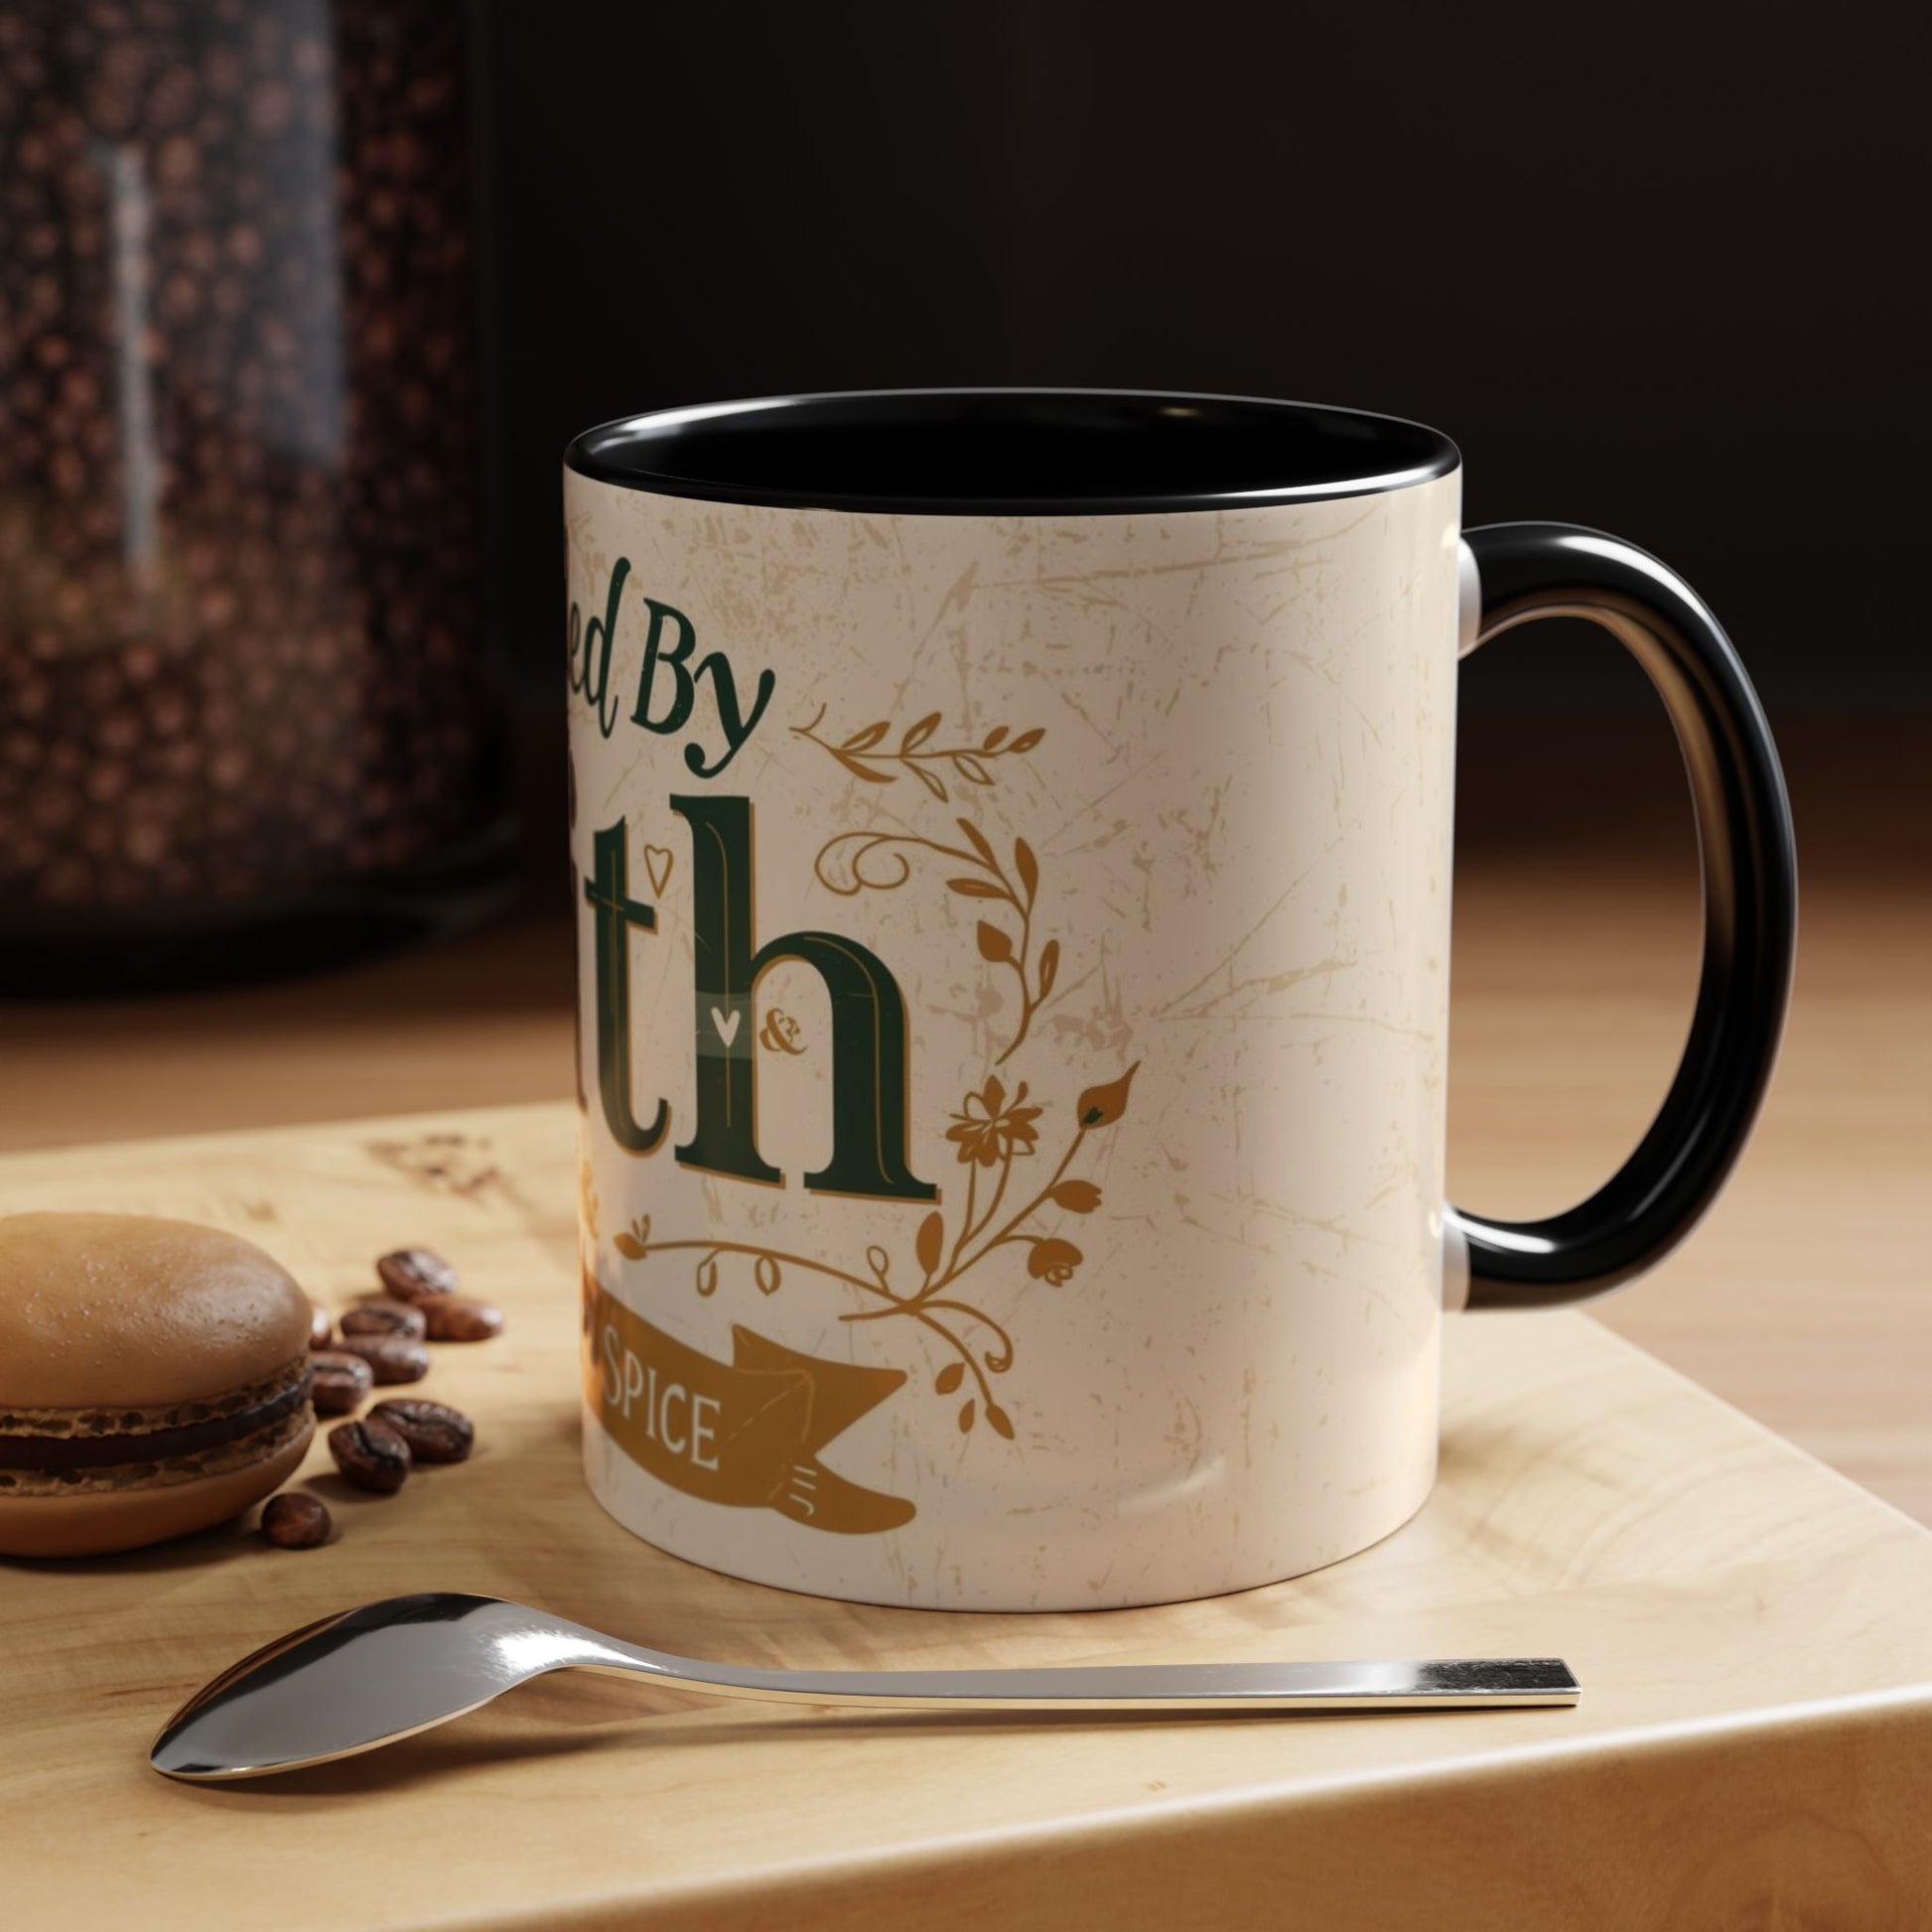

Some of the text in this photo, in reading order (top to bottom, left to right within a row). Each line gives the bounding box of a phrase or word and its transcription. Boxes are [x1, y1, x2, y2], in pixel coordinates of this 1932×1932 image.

[630, 598, 775, 778] By
[570, 745, 942, 1205] th
[604, 1323, 721, 1470] SPICE
